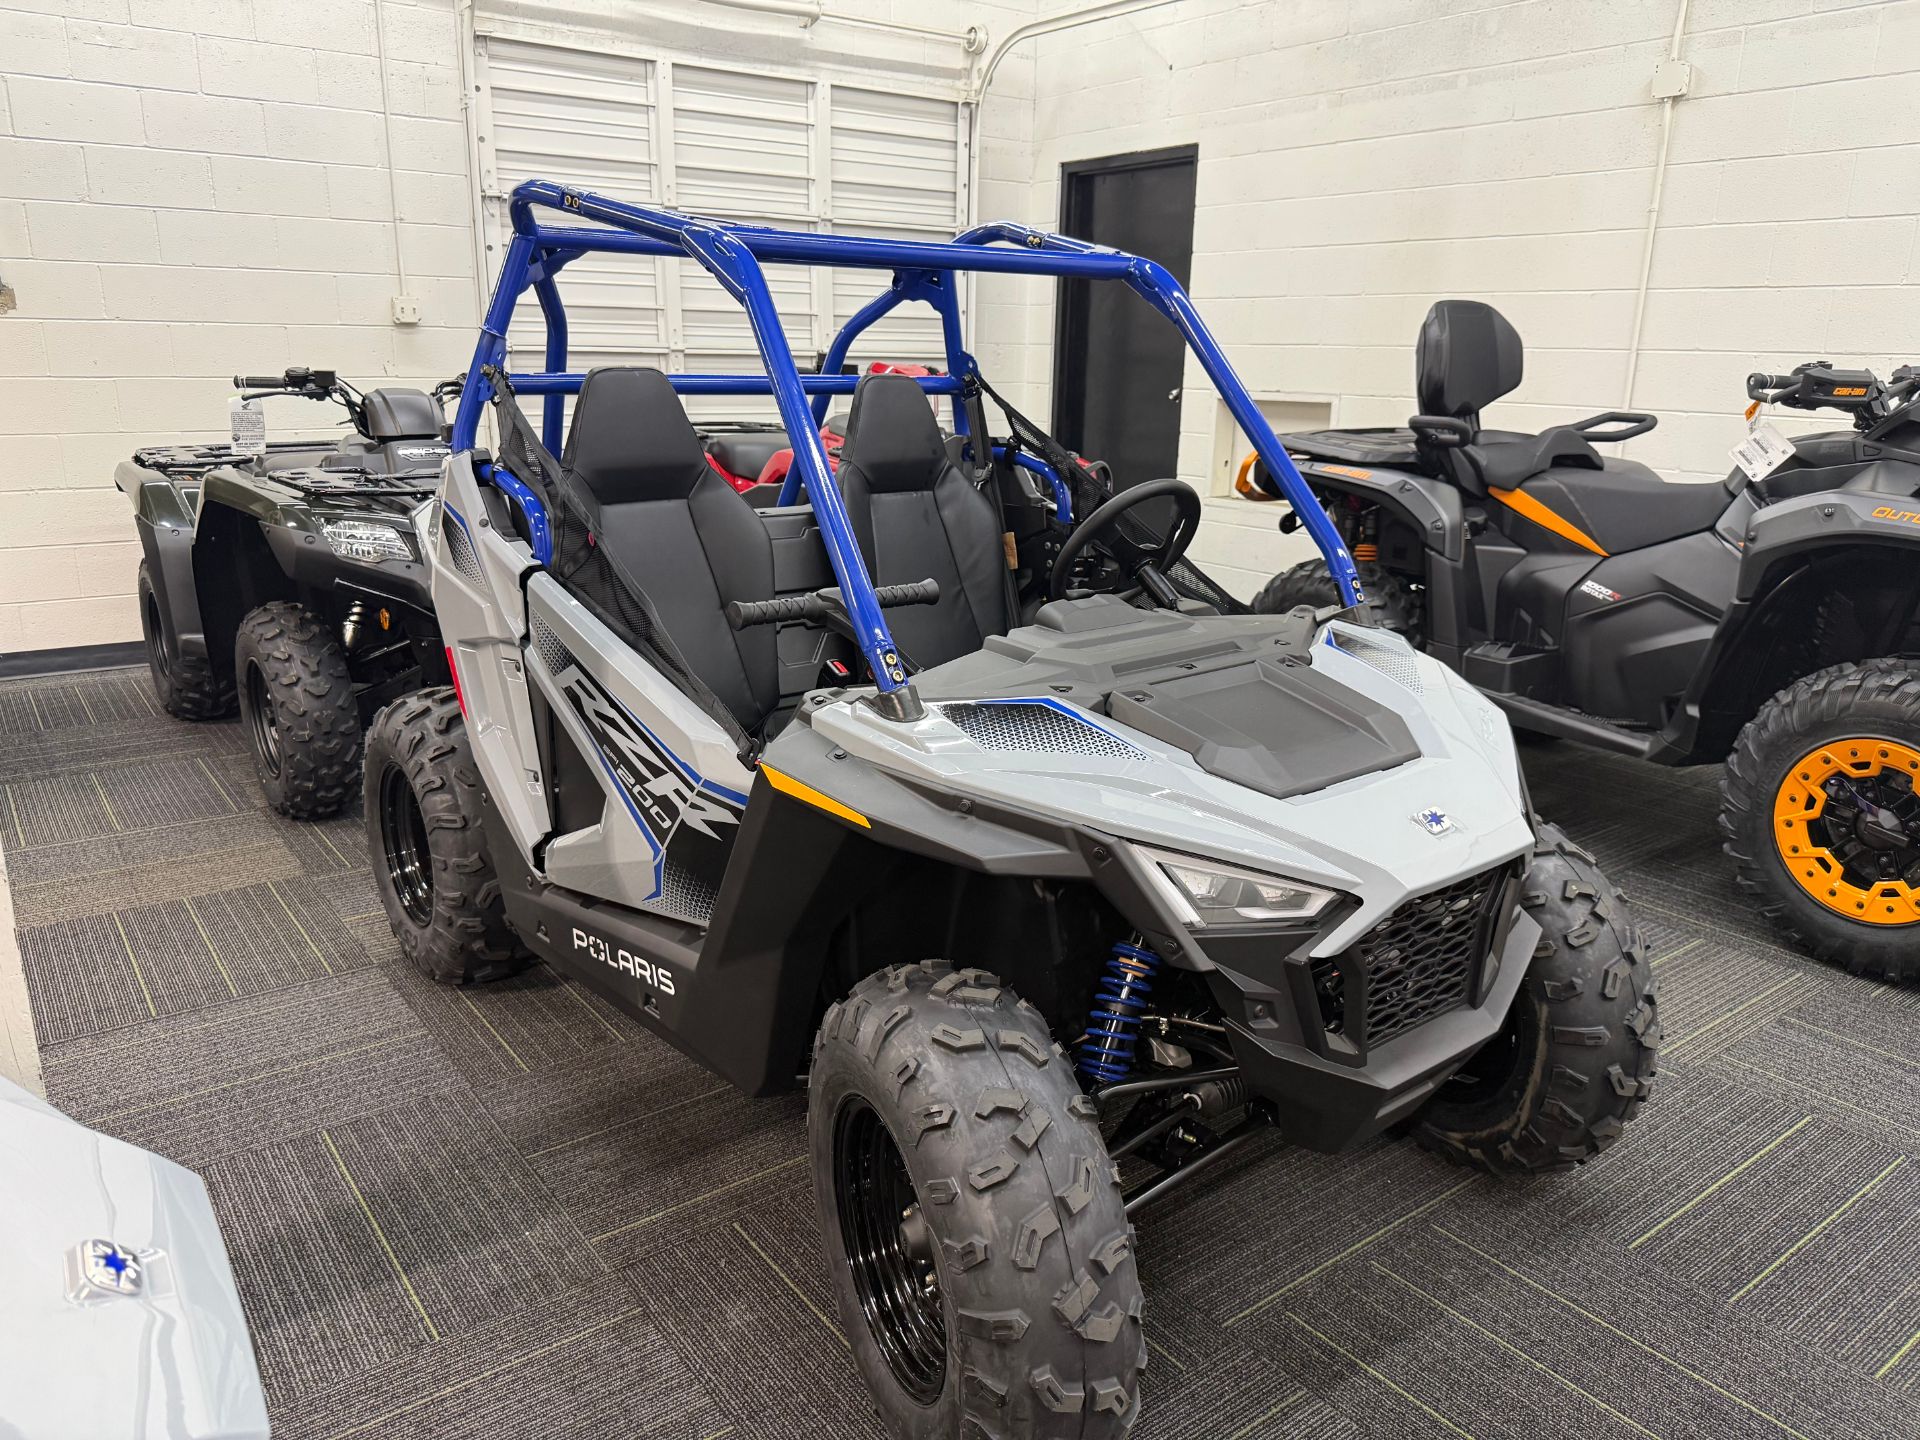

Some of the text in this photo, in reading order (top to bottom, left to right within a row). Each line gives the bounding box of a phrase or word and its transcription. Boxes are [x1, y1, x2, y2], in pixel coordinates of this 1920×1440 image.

[553, 663, 741, 842] RZR
[616, 764, 673, 829] 200
[572, 927, 676, 996] POLARIS
